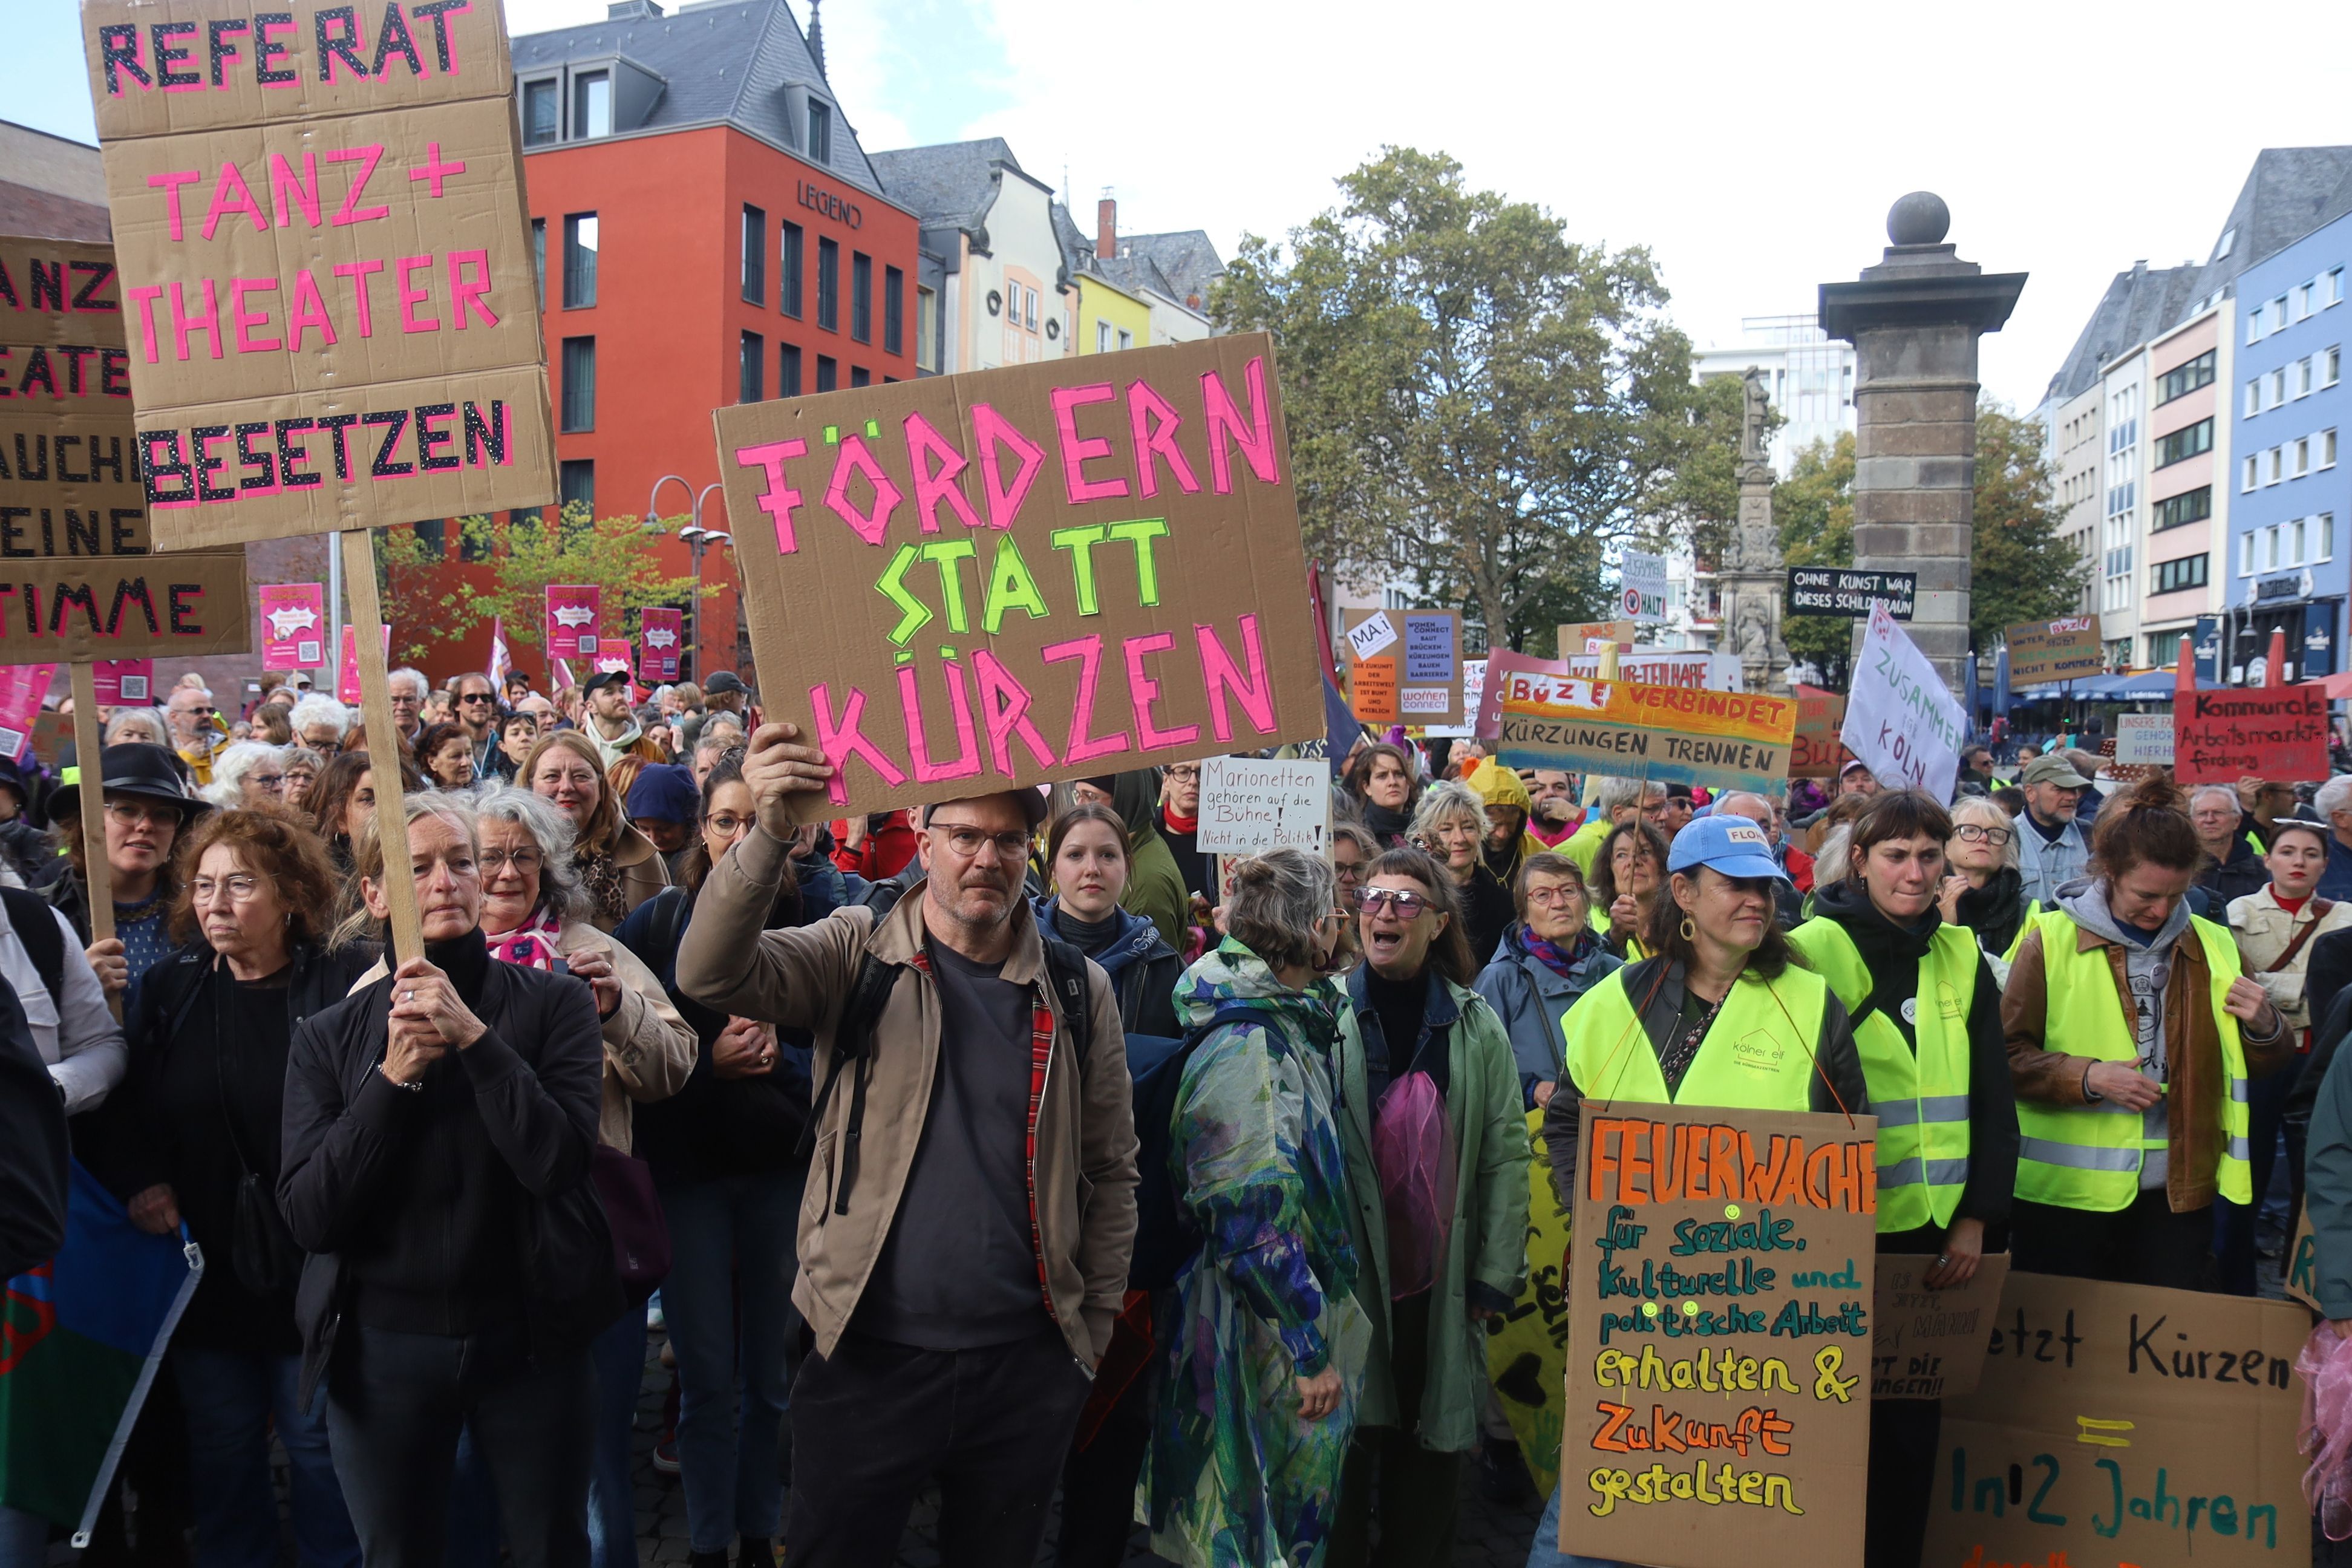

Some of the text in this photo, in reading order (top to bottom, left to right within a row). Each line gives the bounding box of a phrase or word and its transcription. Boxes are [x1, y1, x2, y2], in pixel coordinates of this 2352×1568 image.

[99, 0, 474, 97] REFERAT
[148, 143, 389, 241] TANZ
[798, 179, 861, 229] LEGEND
[129, 249, 500, 363] THEATER
[138, 400, 513, 509] BESETZEN
[735, 354, 1280, 555] FÖRDERN
[874, 517, 1171, 648] STATT
[1794, 572, 1829, 586] OHNE
[1838, 573, 1880, 590] KUNST
[2013, 664, 2045, 676] NICHT
[808, 613, 1276, 807] KÜRZEN
[1874, 647, 1963, 760] ZUSAMMEN
[1206, 760, 1314, 787] Marionetten
[1501, 718, 1774, 772] KÜRZUNGEN TRENNEN
[1207, 788, 1312, 810] gehören auf die
[1202, 825, 1322, 851] Nicht in die Politik!
[1733, 1041, 1785, 1060] kölner elf
[1587, 1116, 1876, 1214] FEUERWACHE
[1596, 1206, 1647, 1261] für
[1791, 1258, 1862, 1289] und
[1601, 1300, 1868, 1344] politische Arbeit
[1987, 1308, 2290, 1390] etzt Kürzen
[1595, 1344, 1860, 1403] erhalten &
[1591, 1400, 1794, 1457] Zukunft
[1588, 1459, 1805, 1517] gestalten
[1952, 1447, 2005, 1518] In
[2092, 1459, 2276, 1550] Jahren
